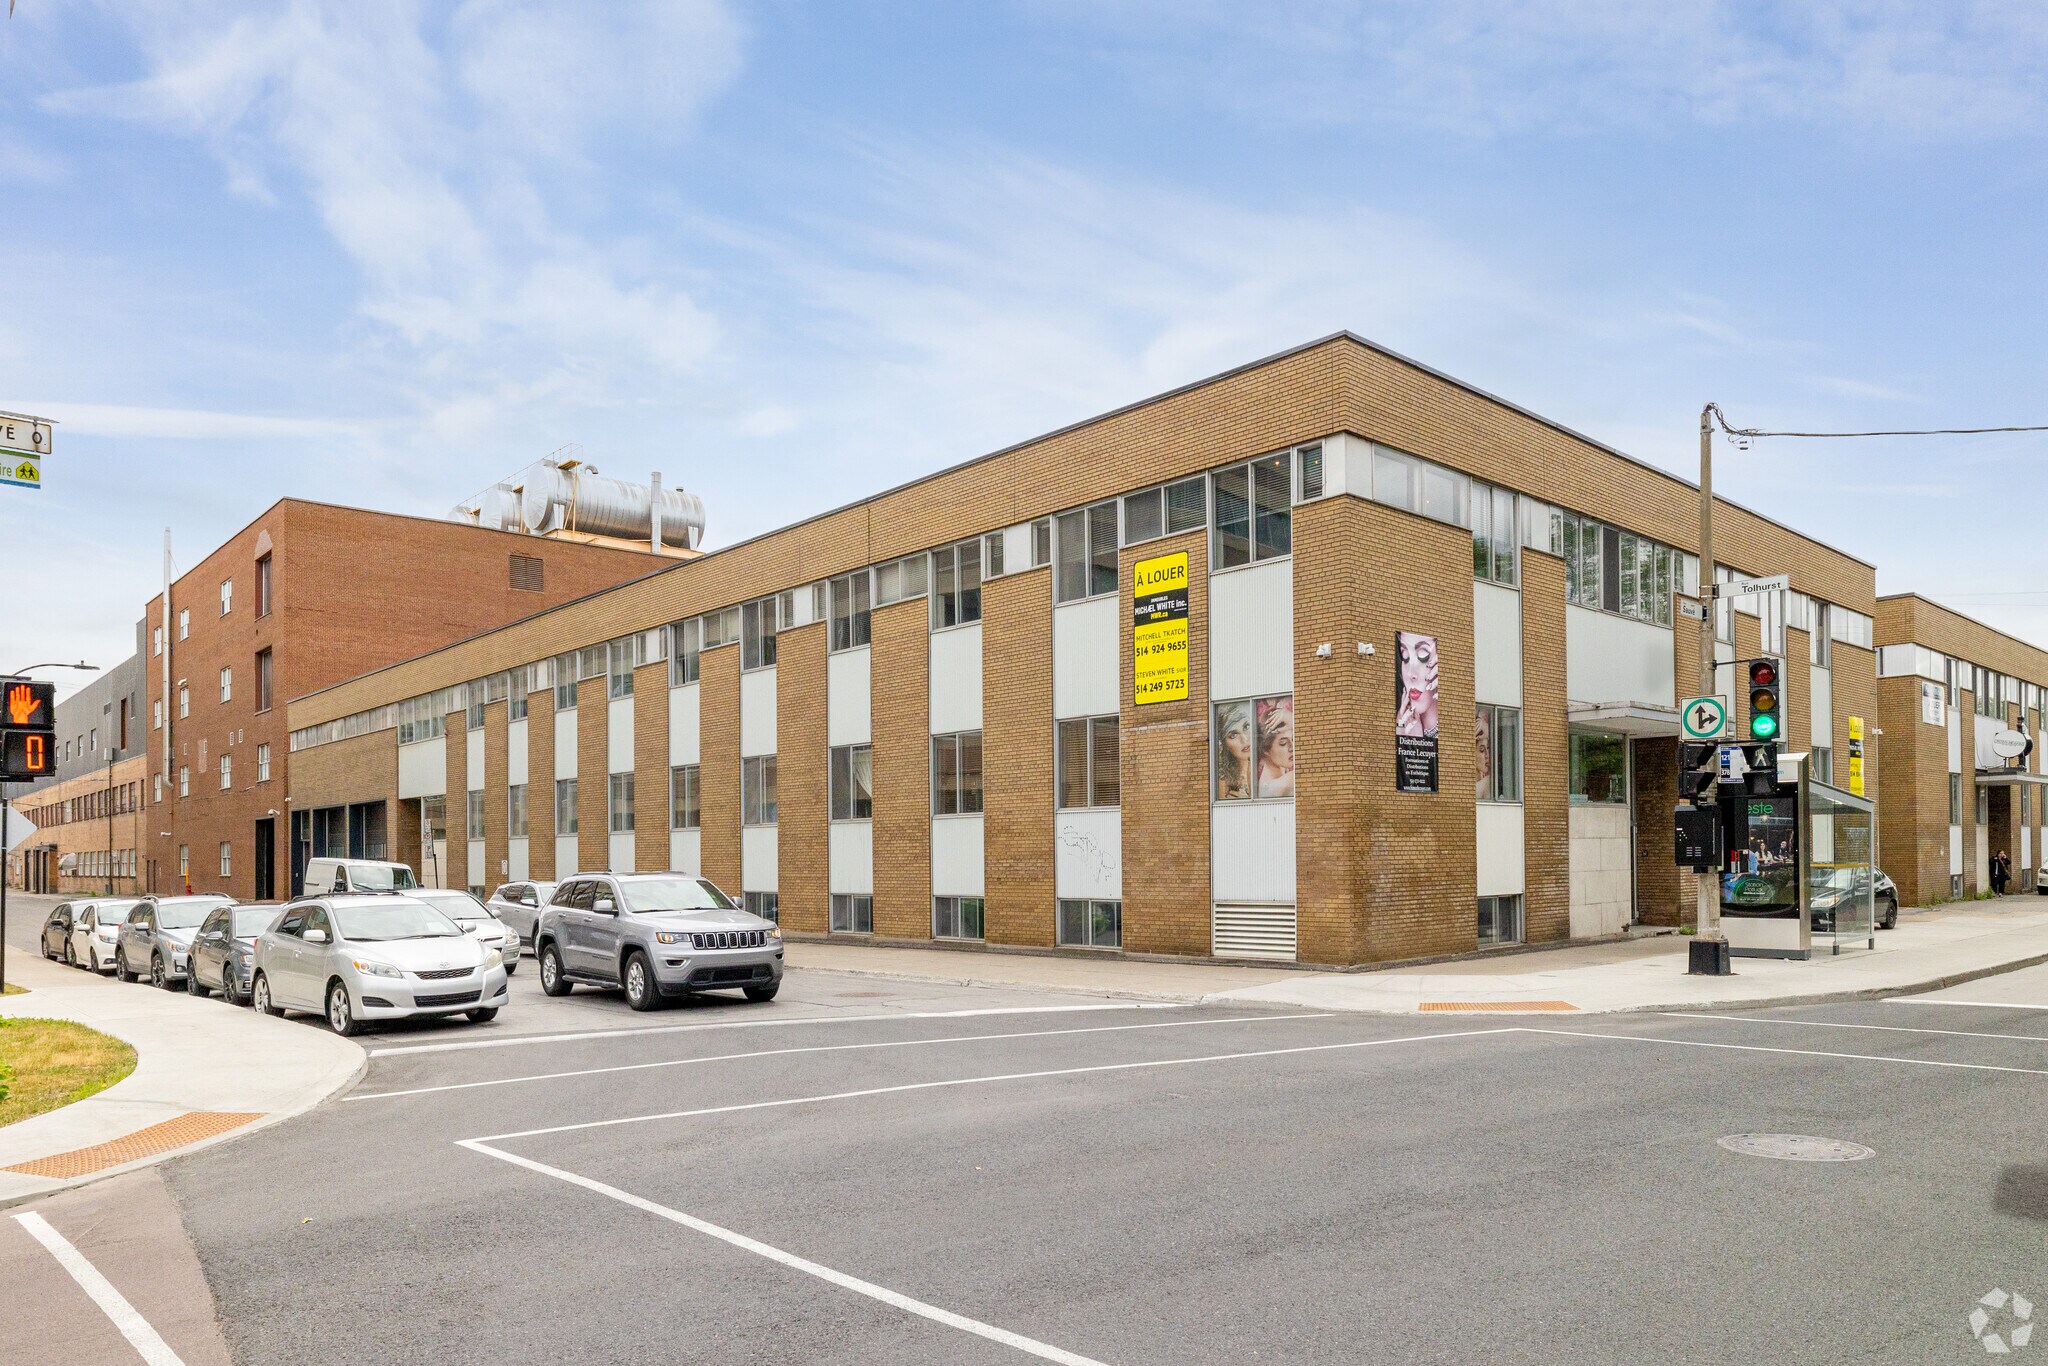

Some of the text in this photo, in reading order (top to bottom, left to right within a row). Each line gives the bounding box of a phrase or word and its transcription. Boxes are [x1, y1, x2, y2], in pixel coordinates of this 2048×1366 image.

[1136, 565, 1185, 587] À LOUER
[1741, 582, 1781, 594] Tolhurst
[1156, 600, 1175, 611] WHITE
[1136, 632, 1161, 642] MITCHELL
[1163, 628, 1186, 637] TKATCH
[1136, 646, 1148, 657] 514
[1151, 643, 1165, 654] 924
[1167, 640, 1187, 652] 9655
[1136, 670, 1156, 680] STEVEN
[1156, 667, 1175, 676] WHITE
[1136, 678, 1185, 694] 514 249 5723
[1399, 736, 1434, 747] Distributions
[1398, 747, 1436, 759] France Lecuyer
